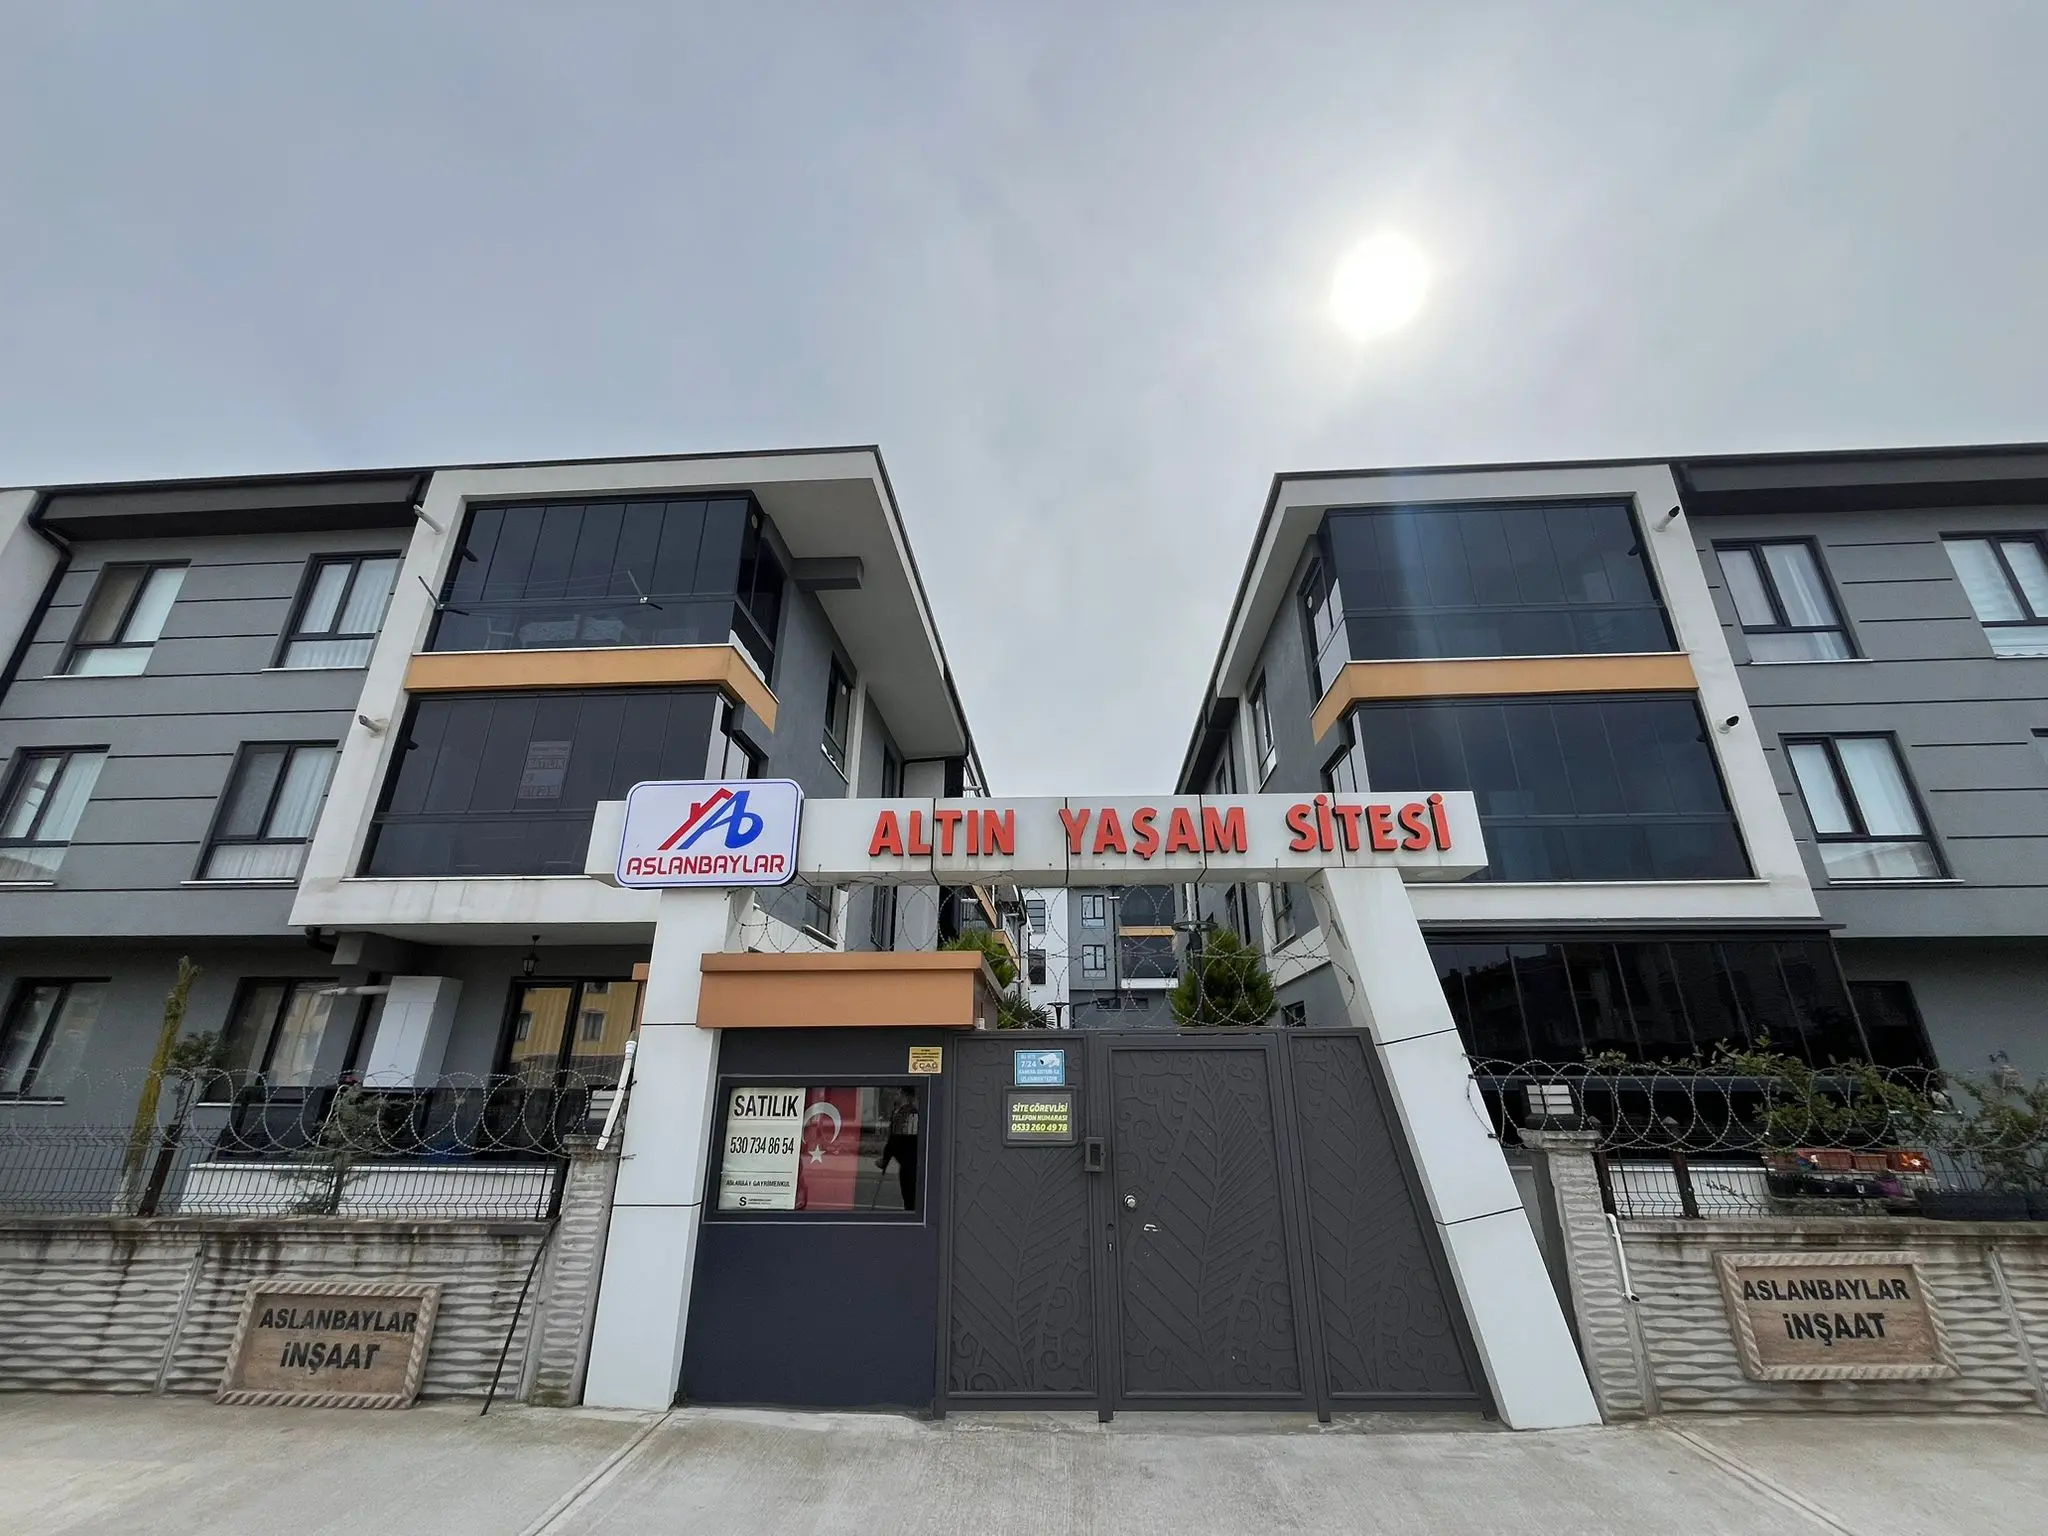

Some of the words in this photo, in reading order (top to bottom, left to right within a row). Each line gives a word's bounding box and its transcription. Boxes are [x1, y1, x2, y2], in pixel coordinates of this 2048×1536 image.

[868, 809, 1015, 856] ALTIN
[1058, 807, 1248, 860] YAŞAM
[1285, 793, 1453, 852] SİTESİ
[626, 854, 785, 876] ASLANBAYLAR
[1020, 1060, 1037, 1068] 7/24
[733, 1095, 799, 1117] SATILIK
[1012, 1102, 1029, 1112] SİTE
[1029, 1102, 1068, 1112] GÖREVLİSİ
[1011, 1123, 1030, 1131] 0533
[1031, 1123, 1046, 1131] 260
[1046, 1123, 1058, 1131] 49
[1058, 1123, 1068, 1131] 78
[730, 1136, 748, 1154] 530
[749, 1136, 767, 1154] 734
[768, 1137, 780, 1155] 86
[781, 1137, 795, 1155] 54
[1743, 1279, 1911, 1301] ASLANBAYLAR
[258, 1308, 418, 1333] ASLANBAYLAR
